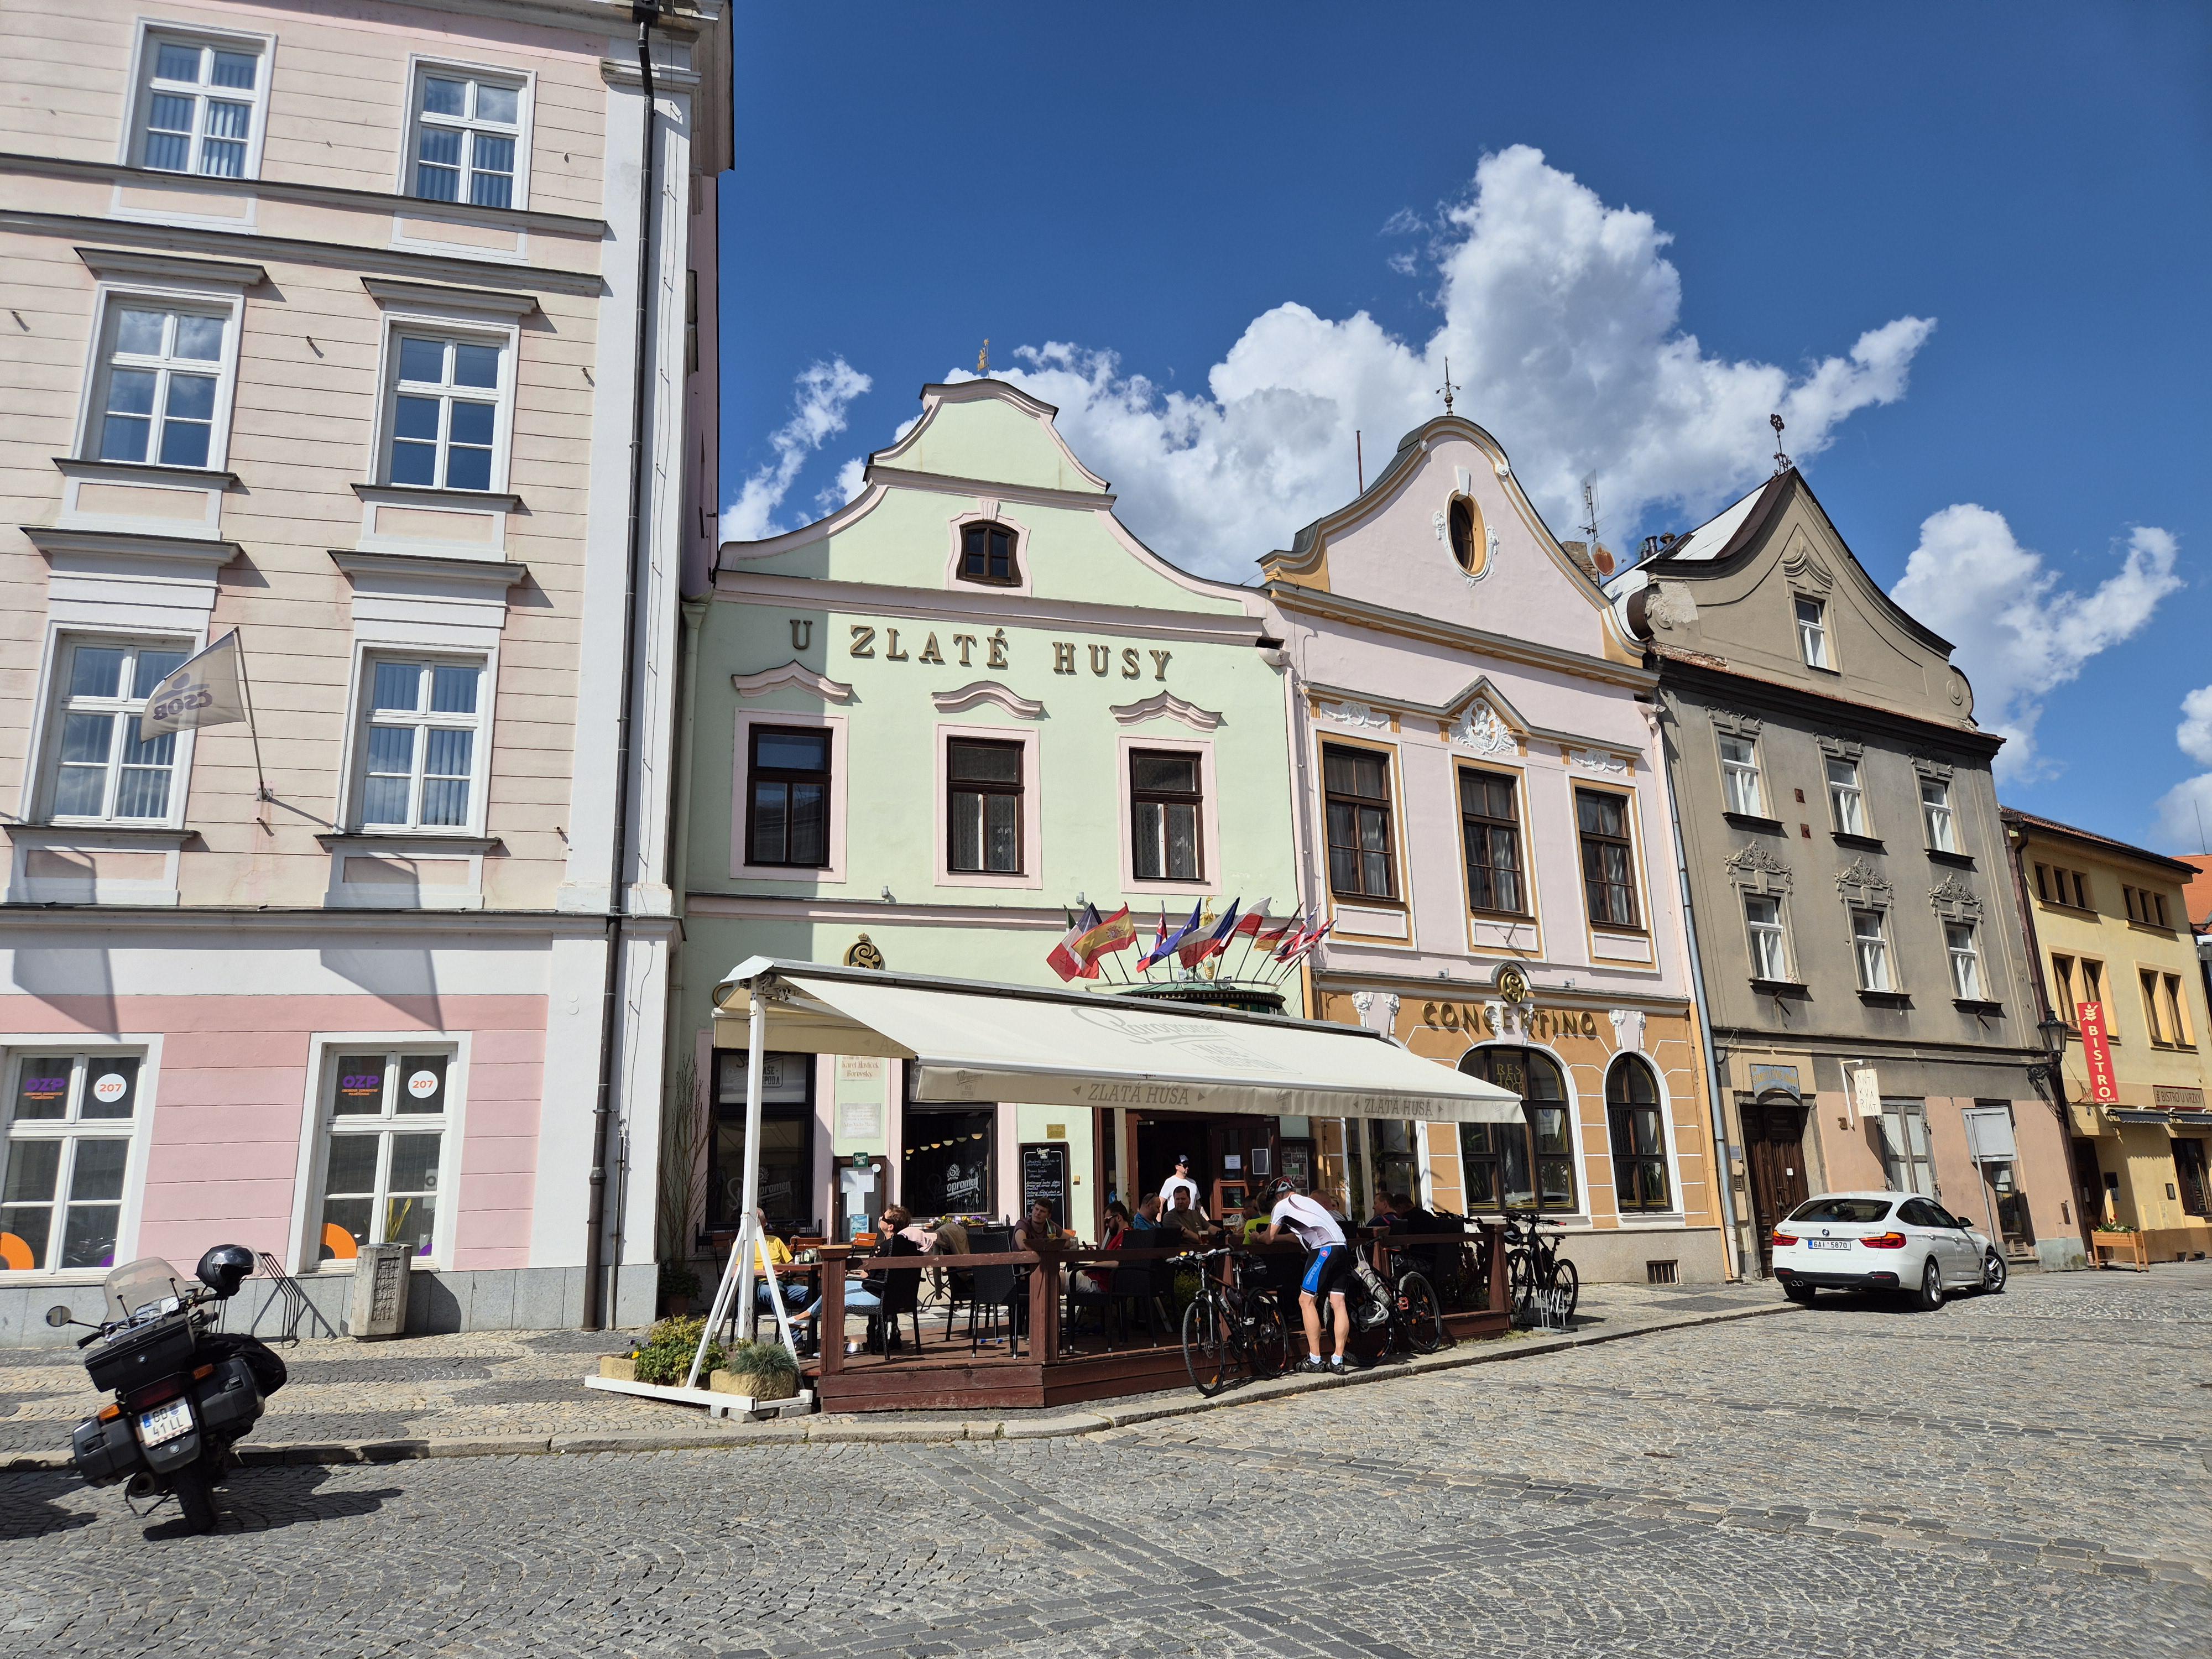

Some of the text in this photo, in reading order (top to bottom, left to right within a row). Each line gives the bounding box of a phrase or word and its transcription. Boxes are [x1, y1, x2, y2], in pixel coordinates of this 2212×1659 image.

[790, 619, 1171, 680] U ZLATÉ HUSY
[1071, 1007, 1245, 1044] Staropramen
[1422, 1001, 1594, 1034] CONCERTINO
[1496, 1063, 1521, 1074] RES
[2088, 1025, 2111, 1098] BISTRO
[25, 1078, 66, 1091] OZP
[343, 1076, 434, 1088] OZP 207
[1087, 1082, 1189, 1105] ZLATÁ HUSA
[2161, 1091, 2179, 1102] BISTRO
[2180, 1093, 2184, 1102] U
[1364, 1097, 1433, 1116] ZLATÁ HUSA
